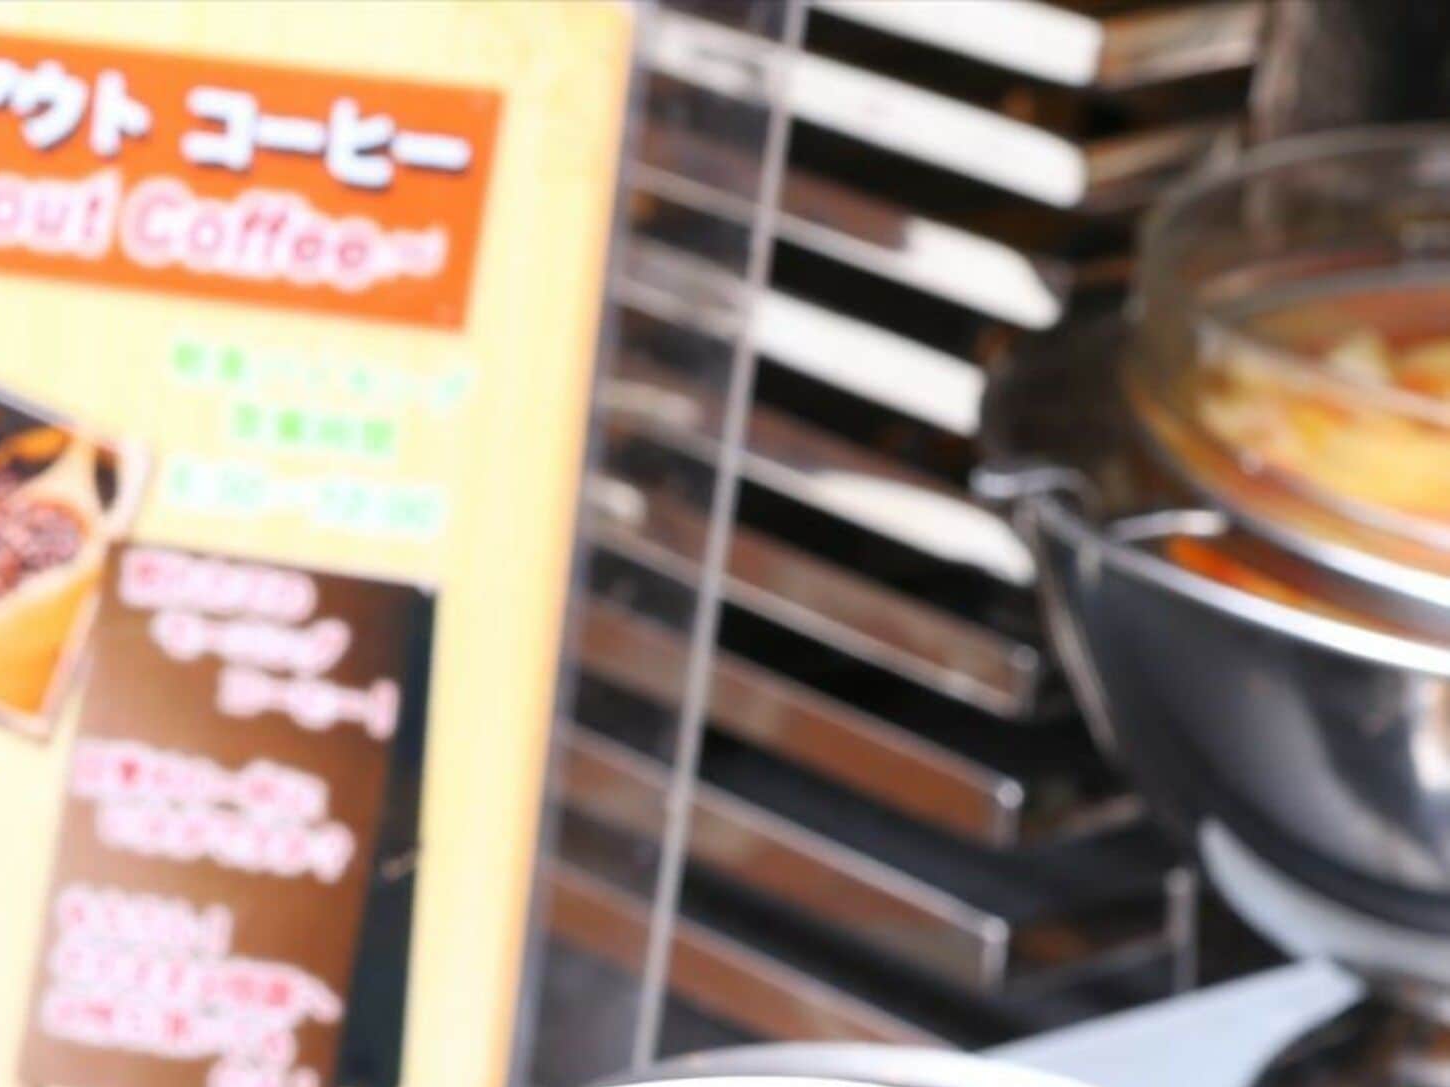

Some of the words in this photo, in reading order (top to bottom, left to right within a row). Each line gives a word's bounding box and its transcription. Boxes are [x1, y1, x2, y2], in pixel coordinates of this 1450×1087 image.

[181, 87, 473, 188] コーヒー
[124, 177, 379, 291] Coffee
